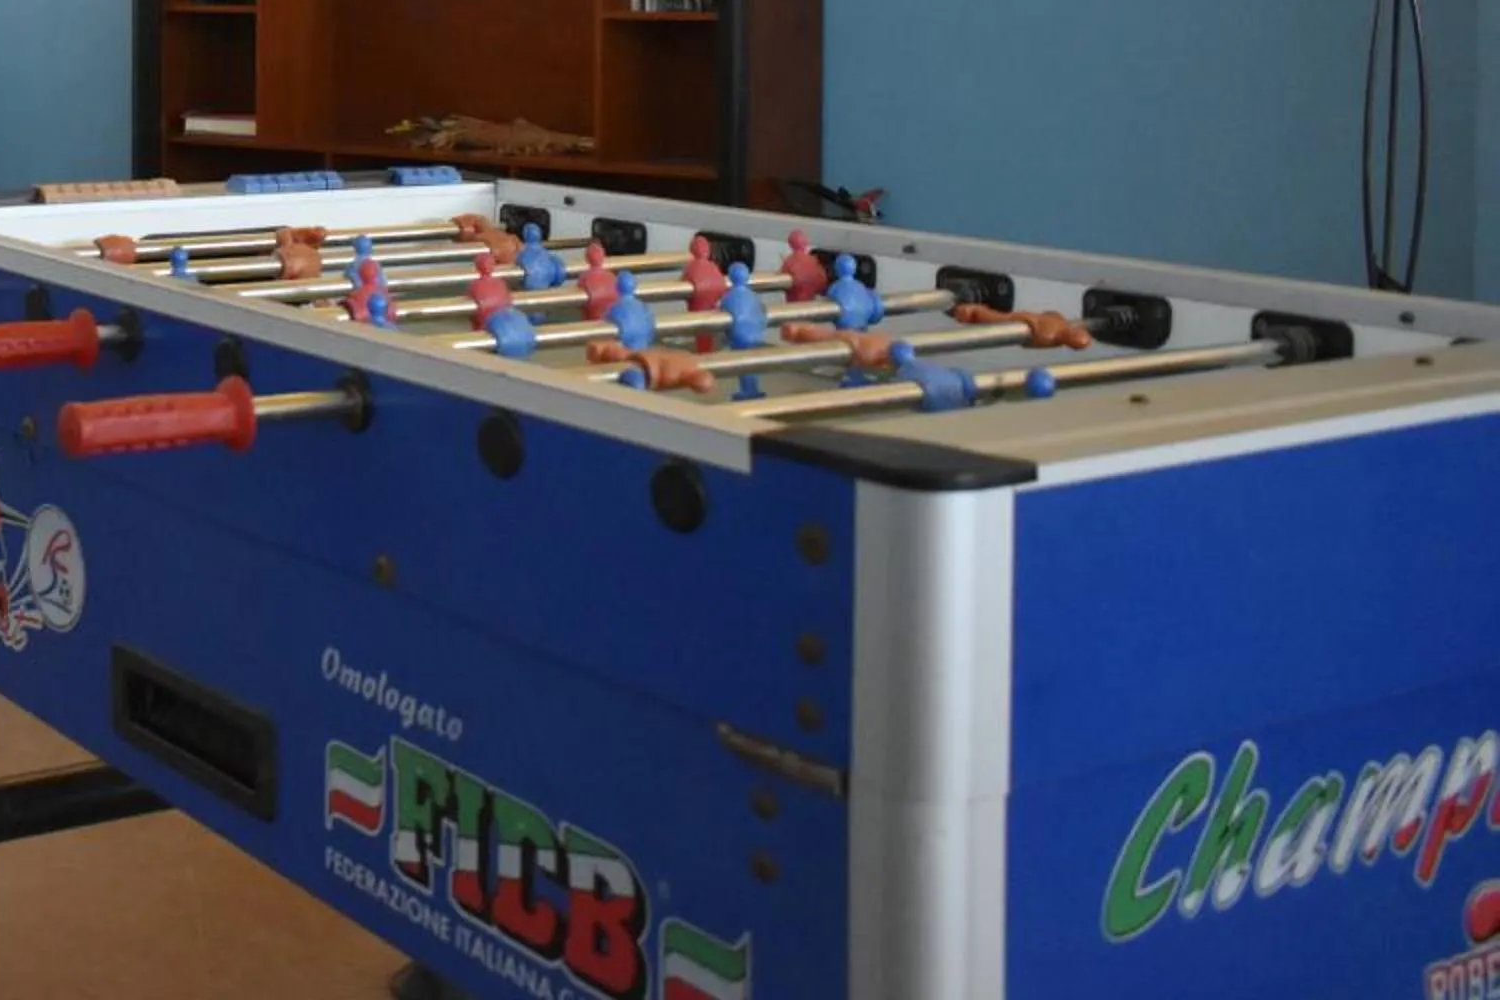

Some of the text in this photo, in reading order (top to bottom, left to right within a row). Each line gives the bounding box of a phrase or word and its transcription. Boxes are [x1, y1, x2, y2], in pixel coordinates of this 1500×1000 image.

[322, 647, 463, 739] Omologato
[324, 847, 554, 1000] FEDERAZIONE ITALIANA
[391, 737, 650, 1000] FICB
[1102, 730, 1500, 942] Champ
